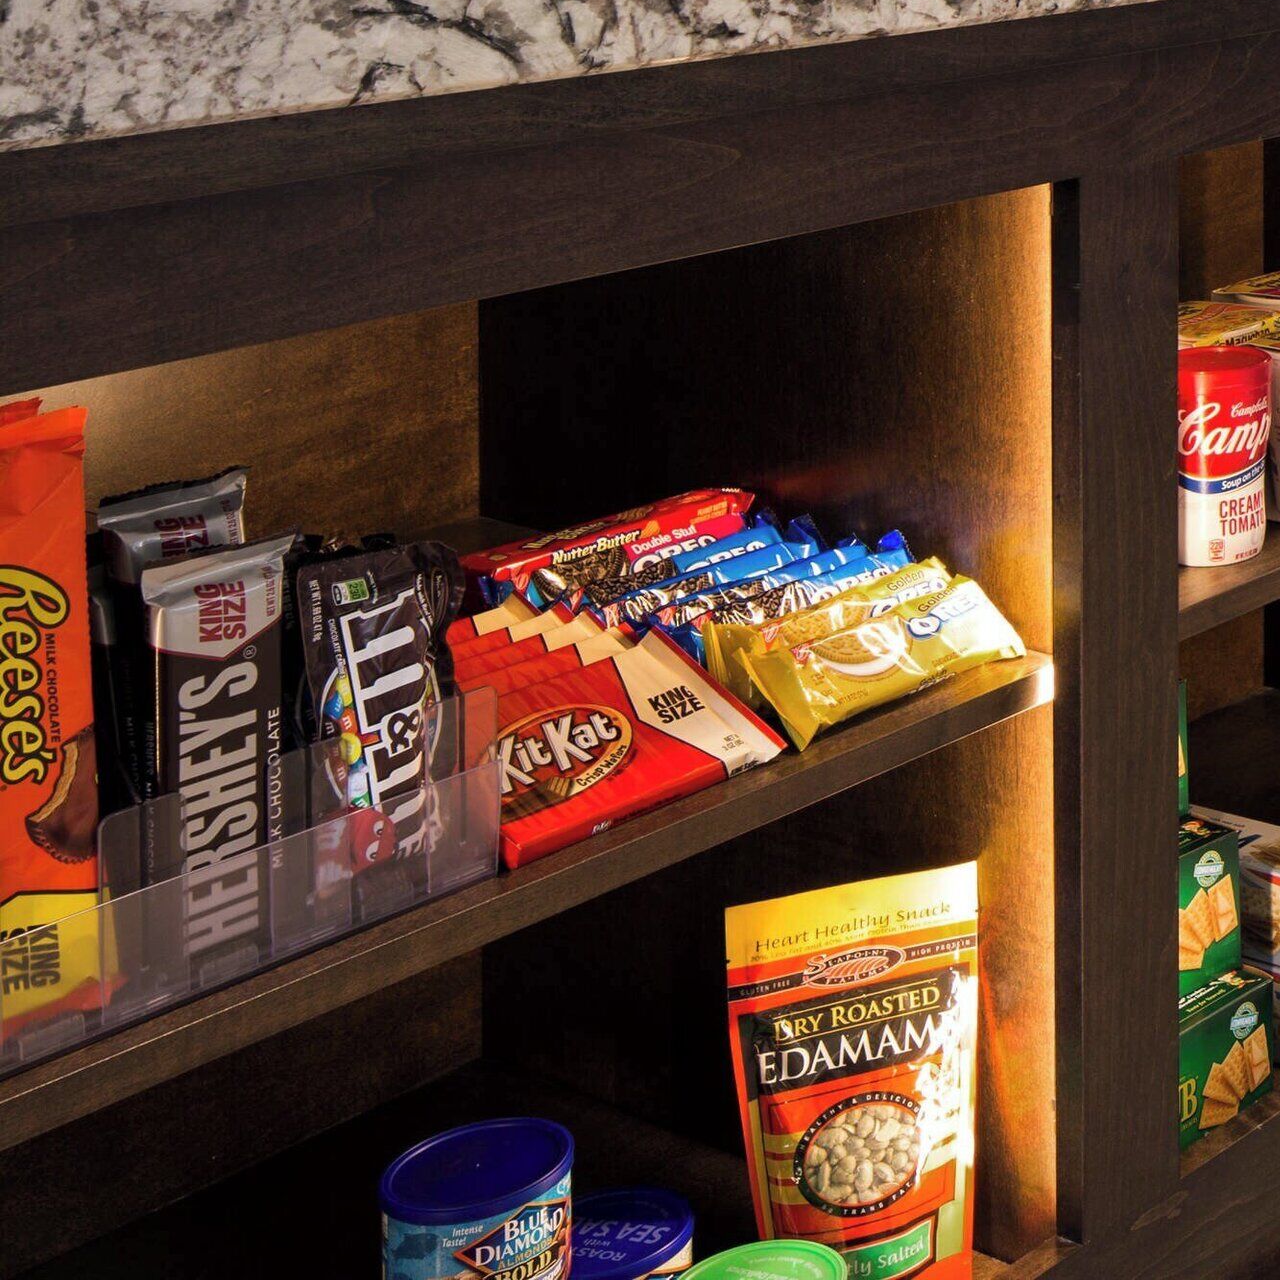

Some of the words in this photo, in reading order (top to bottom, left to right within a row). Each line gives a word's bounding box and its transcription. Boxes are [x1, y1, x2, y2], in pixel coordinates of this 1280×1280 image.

[1221, 476, 1243, 491] Soup
[552, 543, 597, 565] Nutter
[597, 529, 640, 552] Butter
[631, 533, 672, 554] Double
[671, 524, 697, 540] Stuf
[886, 569, 925, 592] Golden
[193, 582, 223, 643] KING
[219, 579, 247, 640] SIZE
[917, 585, 960, 613] Golden
[45, 632, 57, 666] MILK
[328, 618, 344, 654] CHOCOLATE
[45, 668, 61, 744] CHOCOLATE
[648, 685, 696, 713] KING
[656, 696, 706, 725] SIZE
[267, 706, 282, 821] CHOCOLATE
[178, 660, 260, 957] HERSHEY'S
[755, 927, 809, 953] Heart
[814, 912, 891, 940] Healthy
[895, 900, 952, 922] Snack
[0, 927, 31, 995] SIZE
[26, 923, 61, 988] KING
[910, 946, 933, 958] HIGH
[772, 978, 791, 991] FREE
[774, 1012, 824, 1044] DRY
[831, 985, 941, 1029] ROASTED
[800, 1104, 845, 1150] HEALTHY
[850, 1097, 859, 1106] &
[842, 1201, 886, 1217] TRANS
[891, 1181, 914, 1202] FAT
[452, 1223, 485, 1240] Intense
[474, 1207, 565, 1269] DIAMOND
[503, 1205, 551, 1243] BLUE
[615, 1223, 672, 1247] SEA
[441, 1235, 469, 1250] Taste!
[876, 1234, 927, 1270] Salted
